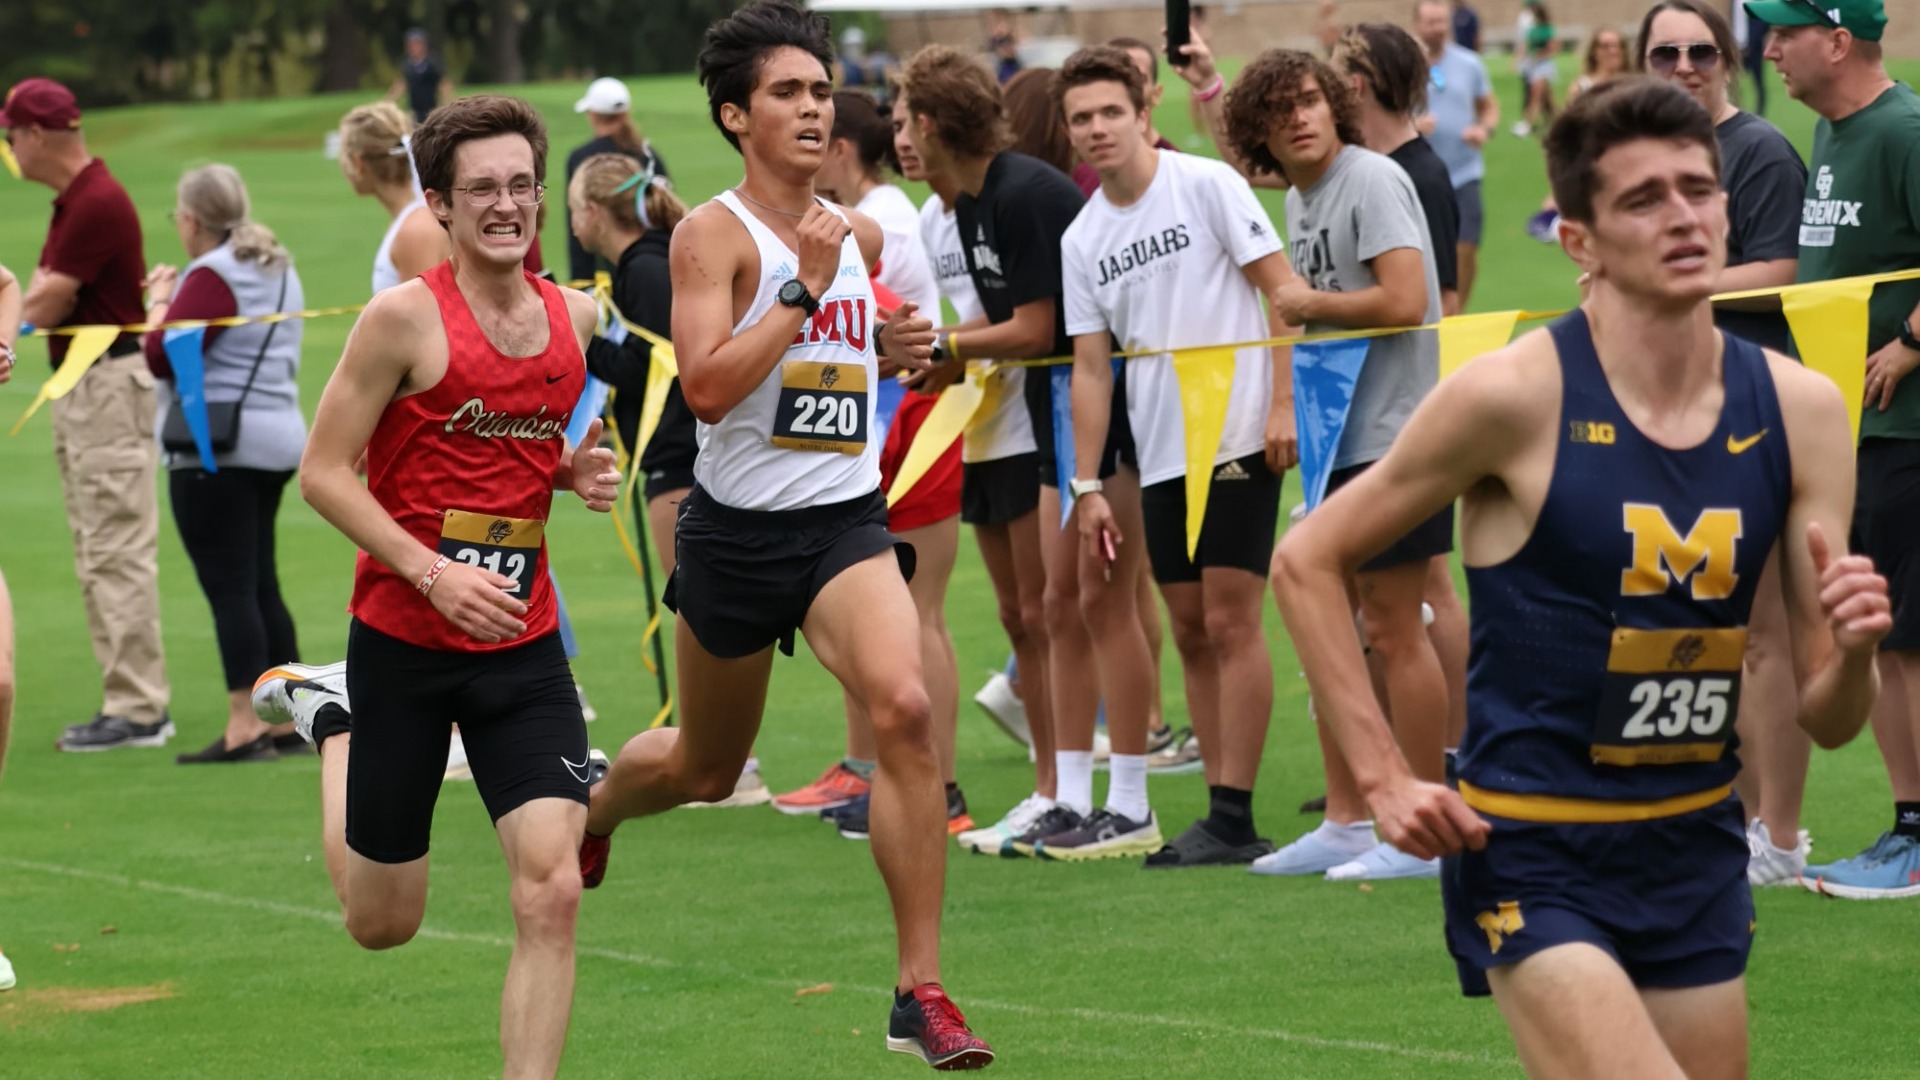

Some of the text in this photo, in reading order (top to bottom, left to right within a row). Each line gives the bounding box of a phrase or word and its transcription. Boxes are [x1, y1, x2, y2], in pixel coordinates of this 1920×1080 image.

[1803, 198, 1863, 227] HOENIX
[1098, 224, 1190, 286] JAGUARS
[790, 395, 858, 436] 220
[1621, 502, 1743, 600] M
[1621, 678, 1732, 738] 235
